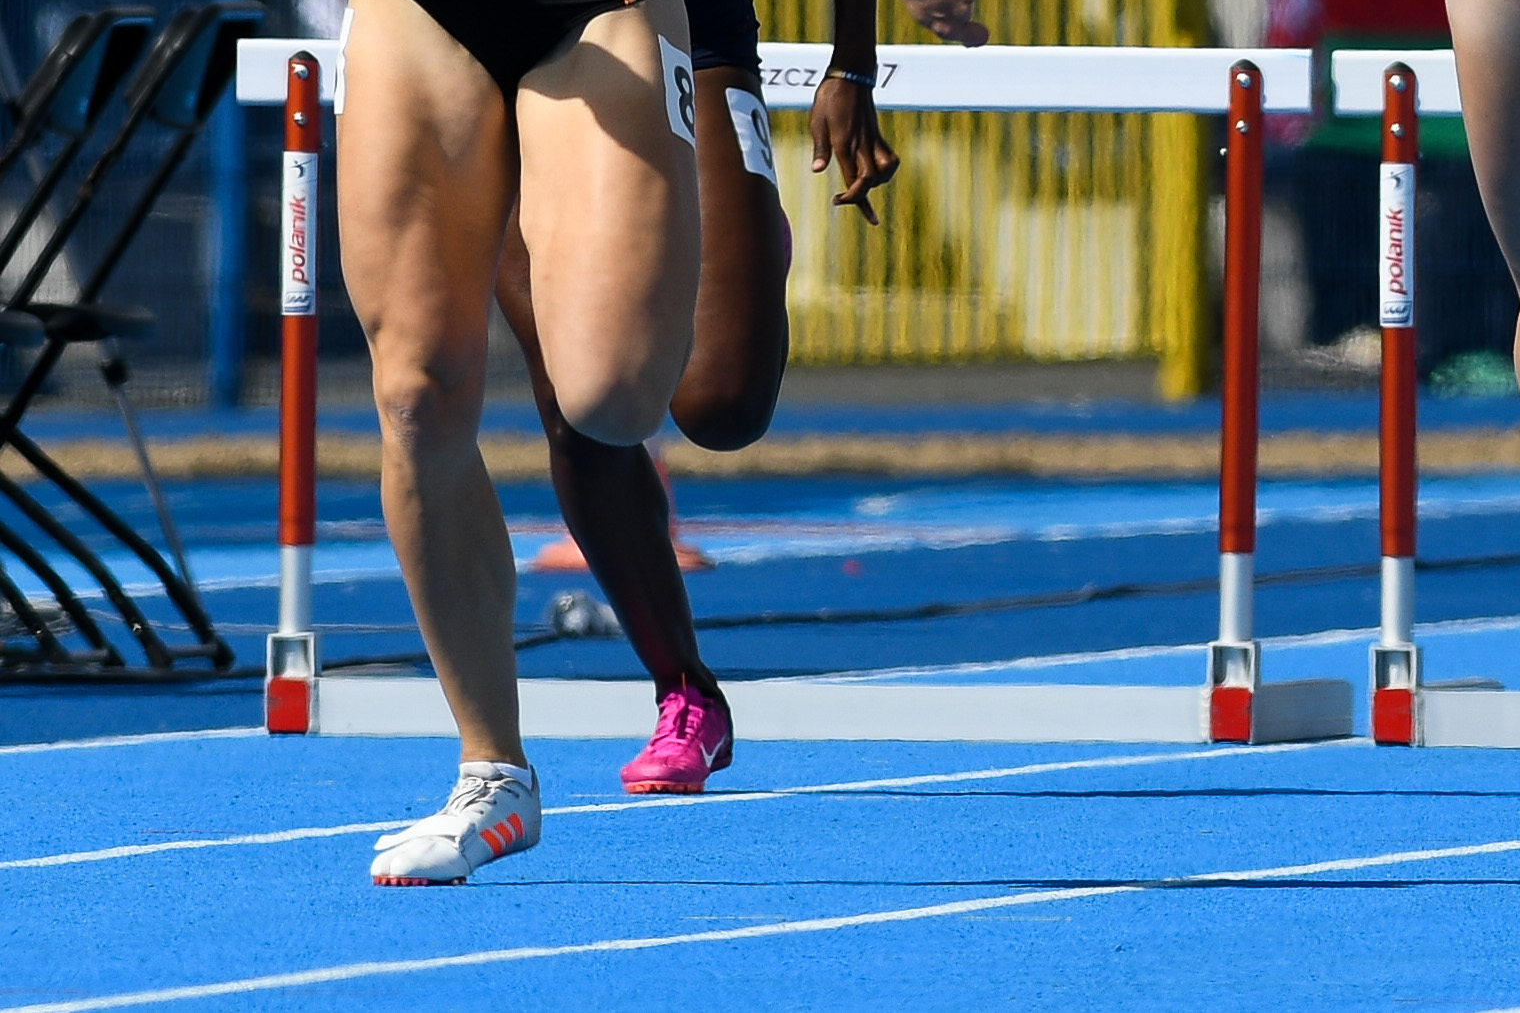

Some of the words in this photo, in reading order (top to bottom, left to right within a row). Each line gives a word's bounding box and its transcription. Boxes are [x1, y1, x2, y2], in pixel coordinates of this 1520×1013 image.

[673, 65, 695, 138] 8
[751, 107, 773, 170] 9
[288, 193, 310, 285] polanik
[1386, 206, 1408, 297] polanik
